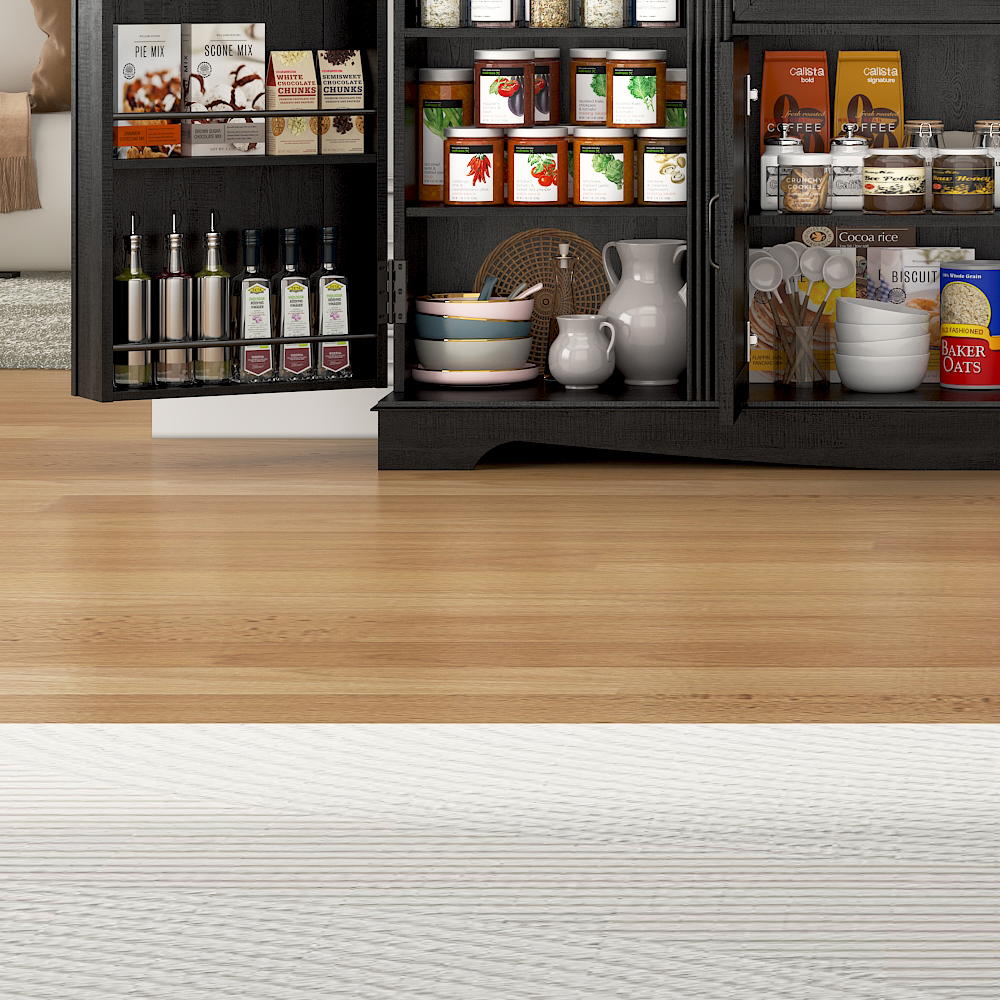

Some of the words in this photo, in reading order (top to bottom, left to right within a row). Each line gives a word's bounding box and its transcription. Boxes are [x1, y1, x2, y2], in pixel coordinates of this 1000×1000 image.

[135, 46, 147, 57] PIE
[151, 46, 165, 57] MIX
[204, 44, 233, 57] SCONE
[237, 44, 253, 57] MIX
[790, 67, 824, 76] calista
[864, 67, 898, 76] calista
[782, 110, 805, 118] fresh
[855, 110, 879, 118] fresh
[839, 232, 874, 242] Cocoa
[878, 232, 898, 242] rice
[806, 239, 831, 247] ORGANIC
[892, 271, 937, 282] BISCUIT
[942, 339, 986, 357] BAKER
[943, 356, 982, 373] OATS
